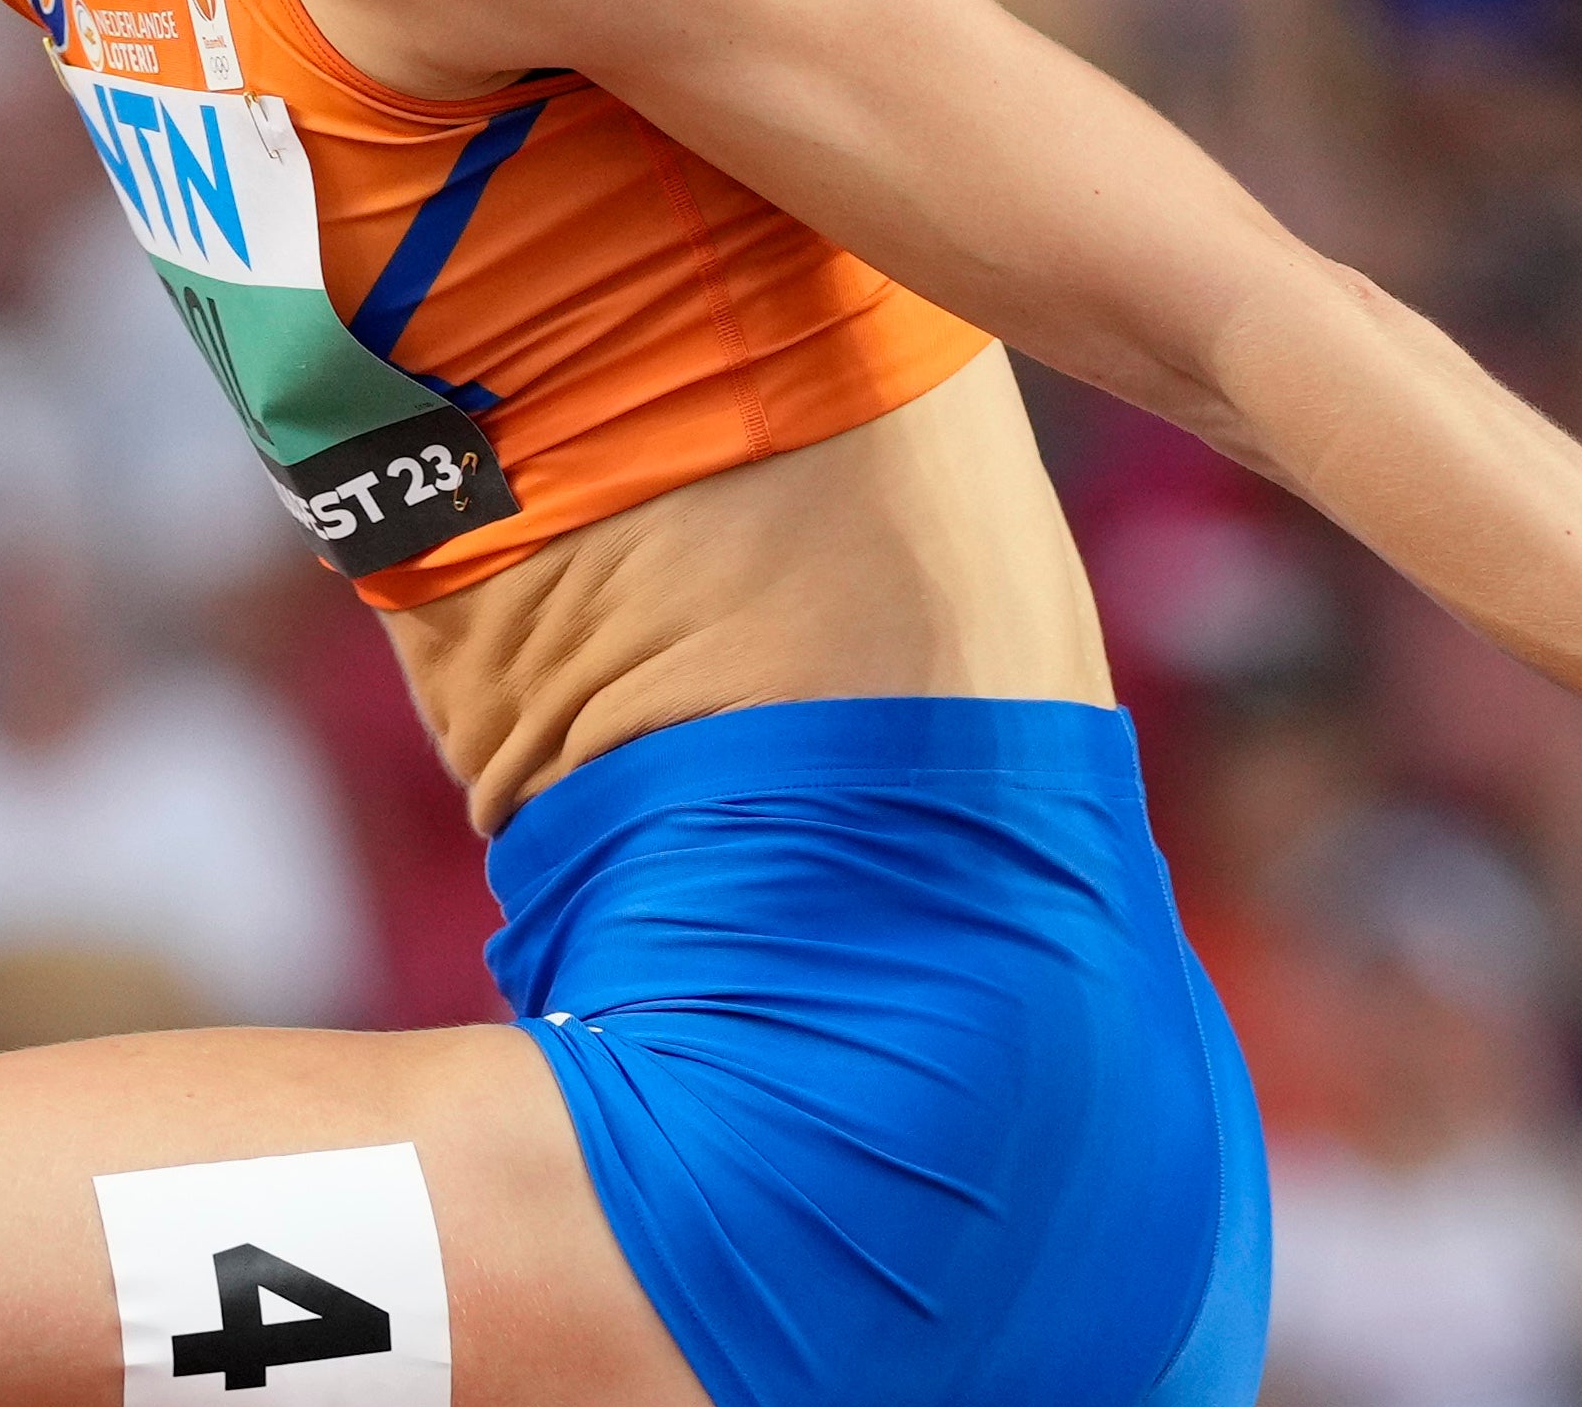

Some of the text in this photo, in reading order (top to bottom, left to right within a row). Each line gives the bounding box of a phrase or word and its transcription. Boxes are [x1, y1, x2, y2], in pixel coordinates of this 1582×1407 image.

[92, 9, 179, 39] NEDERLANDSE
[102, 40, 160, 74] LOTERIJ
[75, 83, 252, 272] NTN
[158, 272, 275, 446] OL
[385, 443, 464, 507] 23
[171, 1242, 392, 1391] 4
